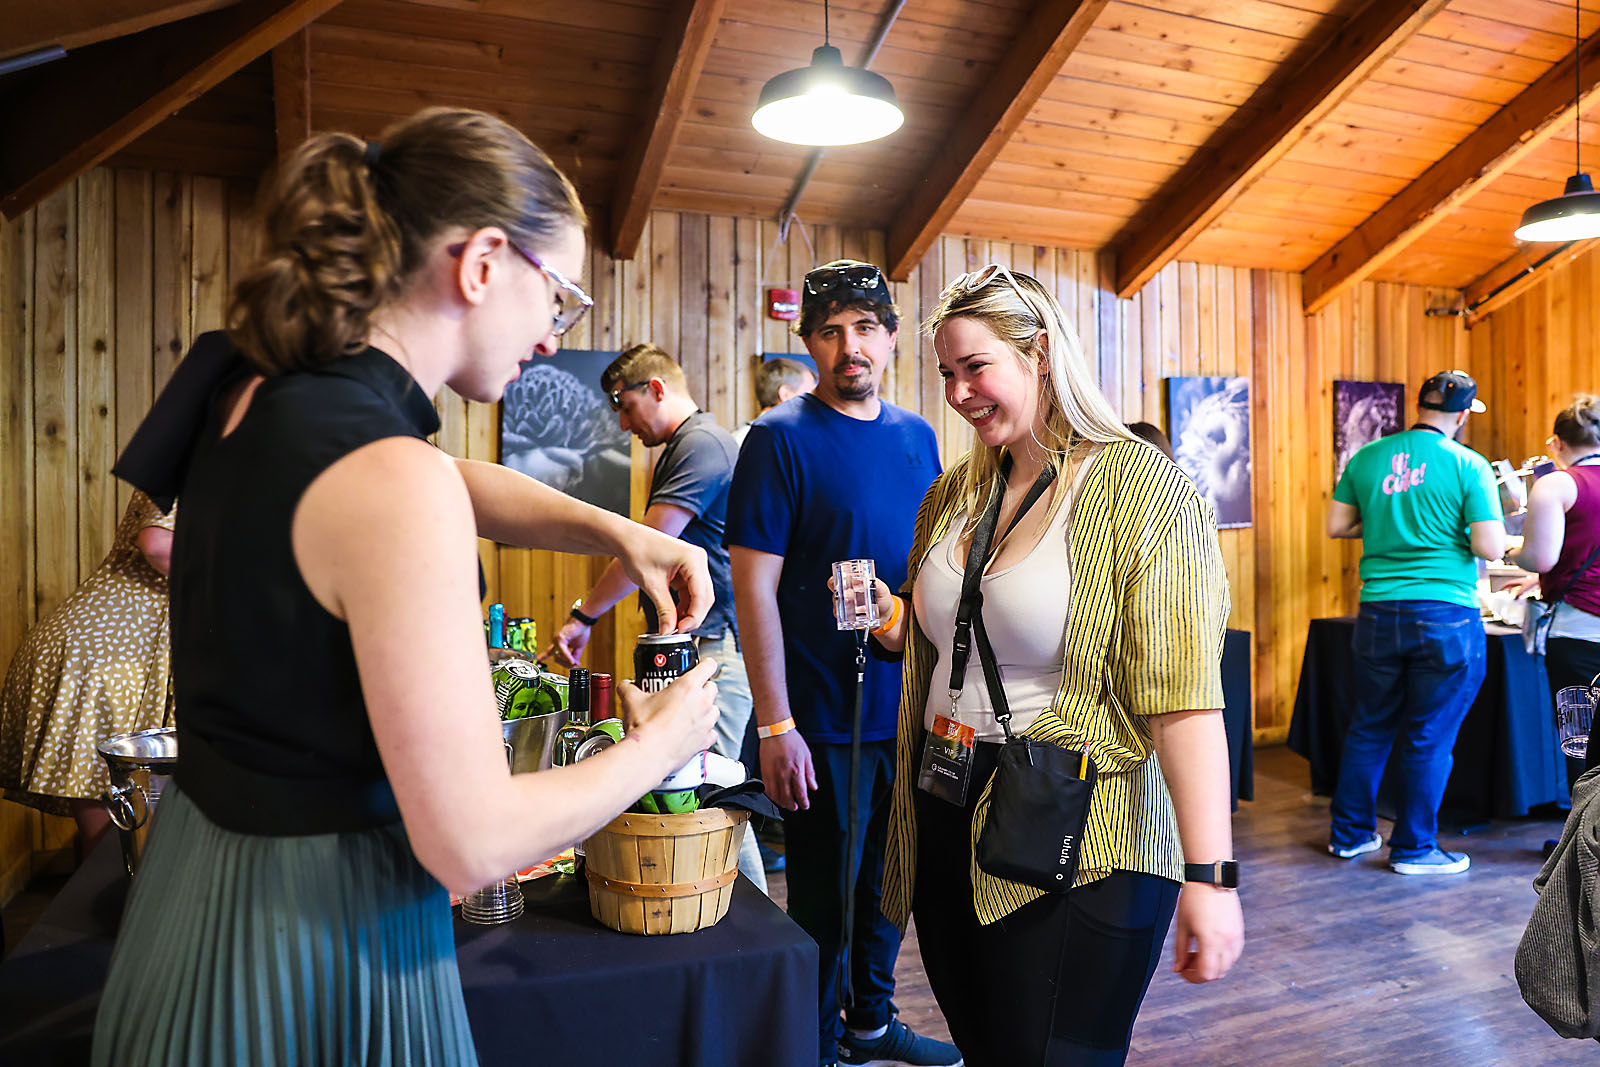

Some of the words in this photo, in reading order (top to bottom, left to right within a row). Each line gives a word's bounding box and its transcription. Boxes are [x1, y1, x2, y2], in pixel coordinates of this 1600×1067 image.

[646, 669, 678, 677] VILLAGE
[642, 677, 680, 694] CID
[943, 746, 954, 756] VIP
